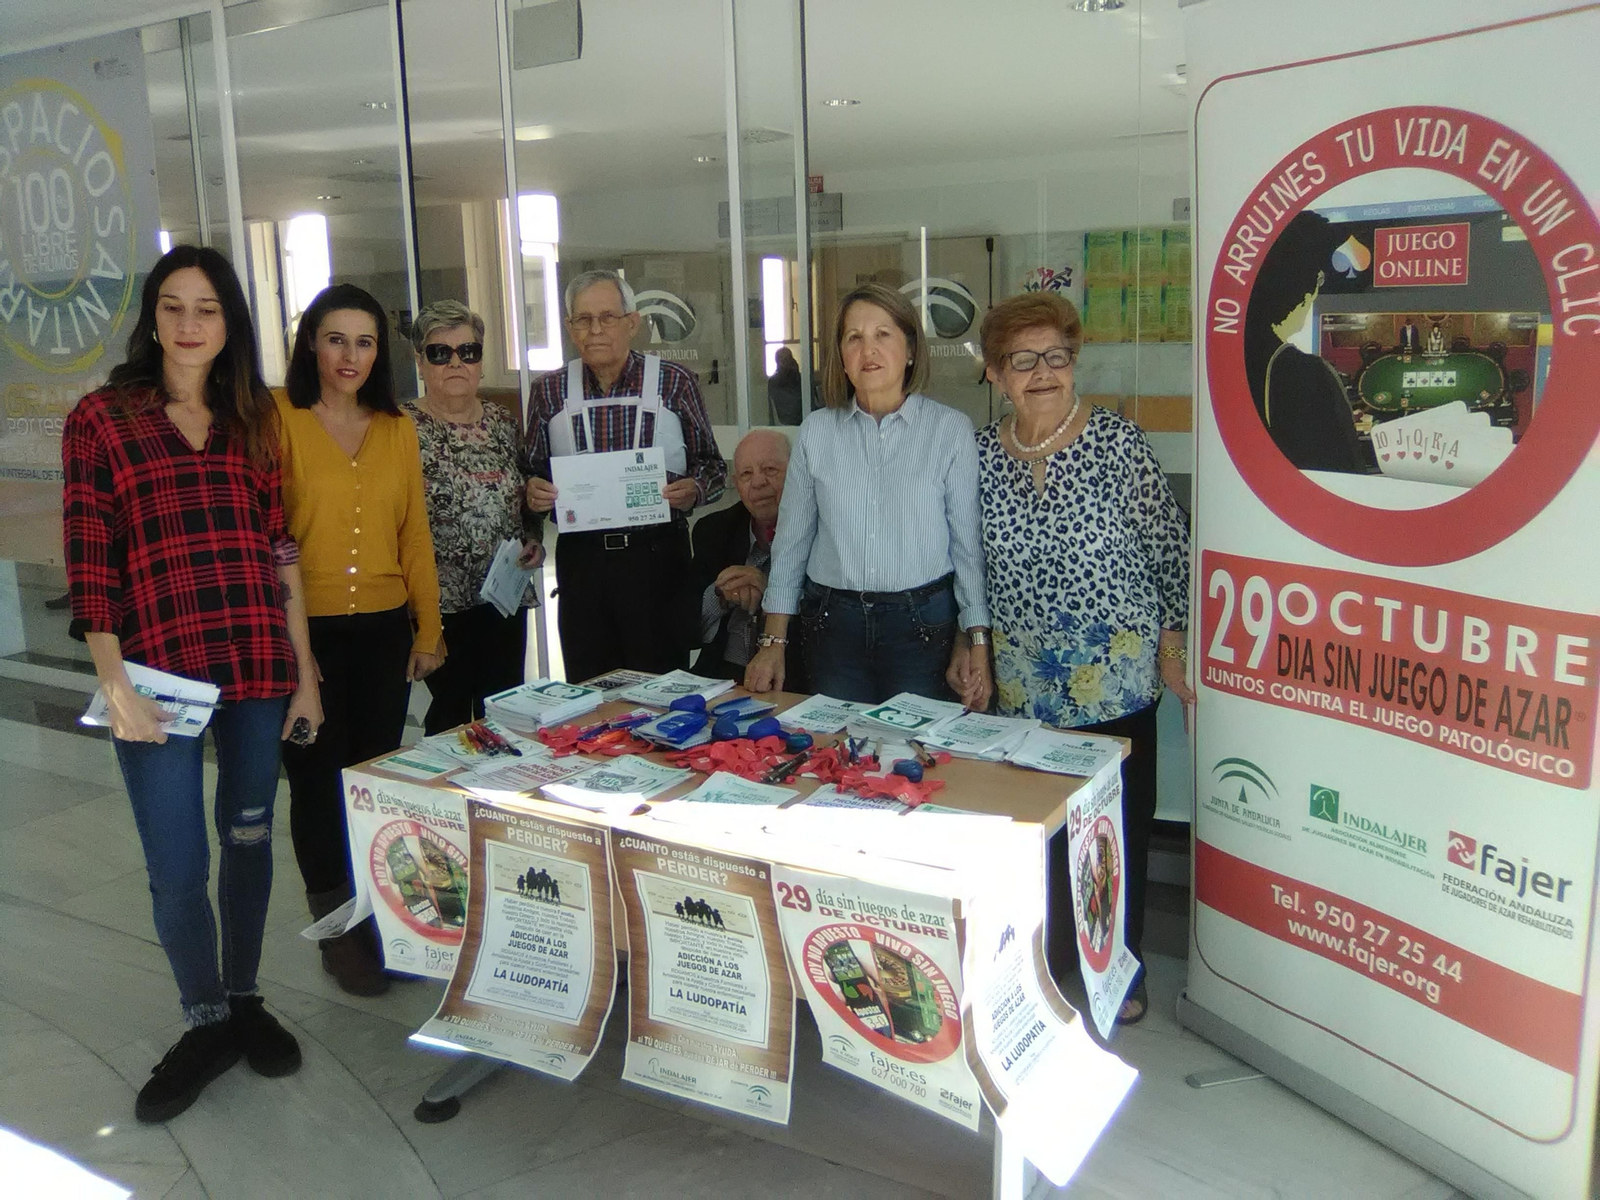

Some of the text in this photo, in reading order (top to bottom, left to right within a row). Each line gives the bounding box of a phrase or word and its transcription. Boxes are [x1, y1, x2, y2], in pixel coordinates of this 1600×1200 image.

[1213, 117, 1600, 337] NO ARRUINES TU VIDA EN UN CLIC
[21, 230, 78, 257] LIBRE
[1387, 231, 1455, 257] JUEGO
[39, 251, 79, 272] HUMOS
[1379, 258, 1462, 278] ONLINE
[1375, 429, 1459, 458] 10 J Q K A
[7, 468, 41, 479] INTEGRAL
[42, 470, 53, 480] DE
[624, 463, 659, 473] INDALAJER
[1208, 569, 1589, 686] 29 OCTUBRE
[1277, 633, 1572, 750] DIA SIN JUEGO DE AZAR
[1206, 666, 1575, 778] JUNTOS CONTRA EL JUEGO PATOLÓGICO
[350, 784, 375, 813] 29
[432, 803, 444, 817] de
[444, 810, 462, 822] azar
[1083, 814, 1093, 829] DE
[1093, 784, 1120, 818] OCTUBRE
[1210, 796, 1229, 810] JUNTA
[1231, 804, 1240, 815] DE
[1242, 808, 1281, 828] ANDALUCIA
[380, 806, 467, 833] DE OCTUBRE
[475, 807, 602, 846] ¿CUANTO estás dispuesto a
[1070, 804, 1082, 841] 29
[1343, 811, 1427, 853] INDALAJER
[377, 821, 412, 848] APUESTO
[420, 826, 446, 848] VIVO
[507, 827, 569, 853] PERDER?
[1312, 829, 1347, 845] JUGADORES
[1348, 841, 1357, 849] DE
[1358, 845, 1375, 856] AZAR
[1375, 851, 1384, 859] EN
[373, 845, 386, 863] NO
[447, 845, 468, 866] SIN
[619, 836, 767, 880] ¿CUANTO estás dispuesto a
[657, 857, 729, 886] PERDER?
[1480, 844, 1573, 903] fajer
[776, 881, 946, 928] 29 día sin juegos de azar
[1441, 883, 1573, 940] DE JUGADORES DE AZAR REHABILITADOS
[1443, 873, 1575, 928] FEDERACIÓN ANDALUZA
[818, 906, 950, 941] DE OCTUBRE
[1271, 884, 1463, 984] Tel. 950 27 25 44
[508, 940, 569, 959] JUEGOS DE AZAR
[510, 930, 545, 944] ADICCIÓN
[553, 939, 568, 949] LOS
[811, 925, 862, 951] APUESTO
[874, 931, 912, 958] VIVO
[425, 945, 457, 963] fajer.
[425, 961, 440, 971] 627
[678, 951, 715, 965] ADICCIÓN
[724, 961, 740, 971] LOS
[807, 944, 821, 962] NO
[911, 953, 939, 978] SIN
[1288, 919, 1441, 1004] www.fajer.org
[493, 967, 569, 994] LA LUDOPATÍA
[677, 960, 742, 980] JUEGOS DE AZAR
[807, 960, 828, 985] HOY
[669, 987, 747, 1016] LA LUDOPATÍA
[932, 977, 959, 1022] JUEGO
[1009, 1004, 1015, 1015] DE
[1014, 992, 1027, 1008] AZAR
[545, 1038, 574, 1052] PERDER
[644, 1035, 653, 1047] TÚ
[654, 1039, 683, 1056] QUIERES,
[705, 1054, 729, 1068] DEJAR
[730, 1061, 739, 1071] de
[739, 1063, 769, 1079] PERDER
[713, 1044, 739, 1058] AYUDA,
[1001, 1054, 1014, 1072] LA
[1010, 1019, 1047, 1061] LUDOPATÍA
[659, 1067, 697, 1084] INDALAJER
[870, 1051, 927, 1086] fajer.es
[871, 1066, 927, 1098] 627 000 780
[948, 1091, 973, 1111] fajer
